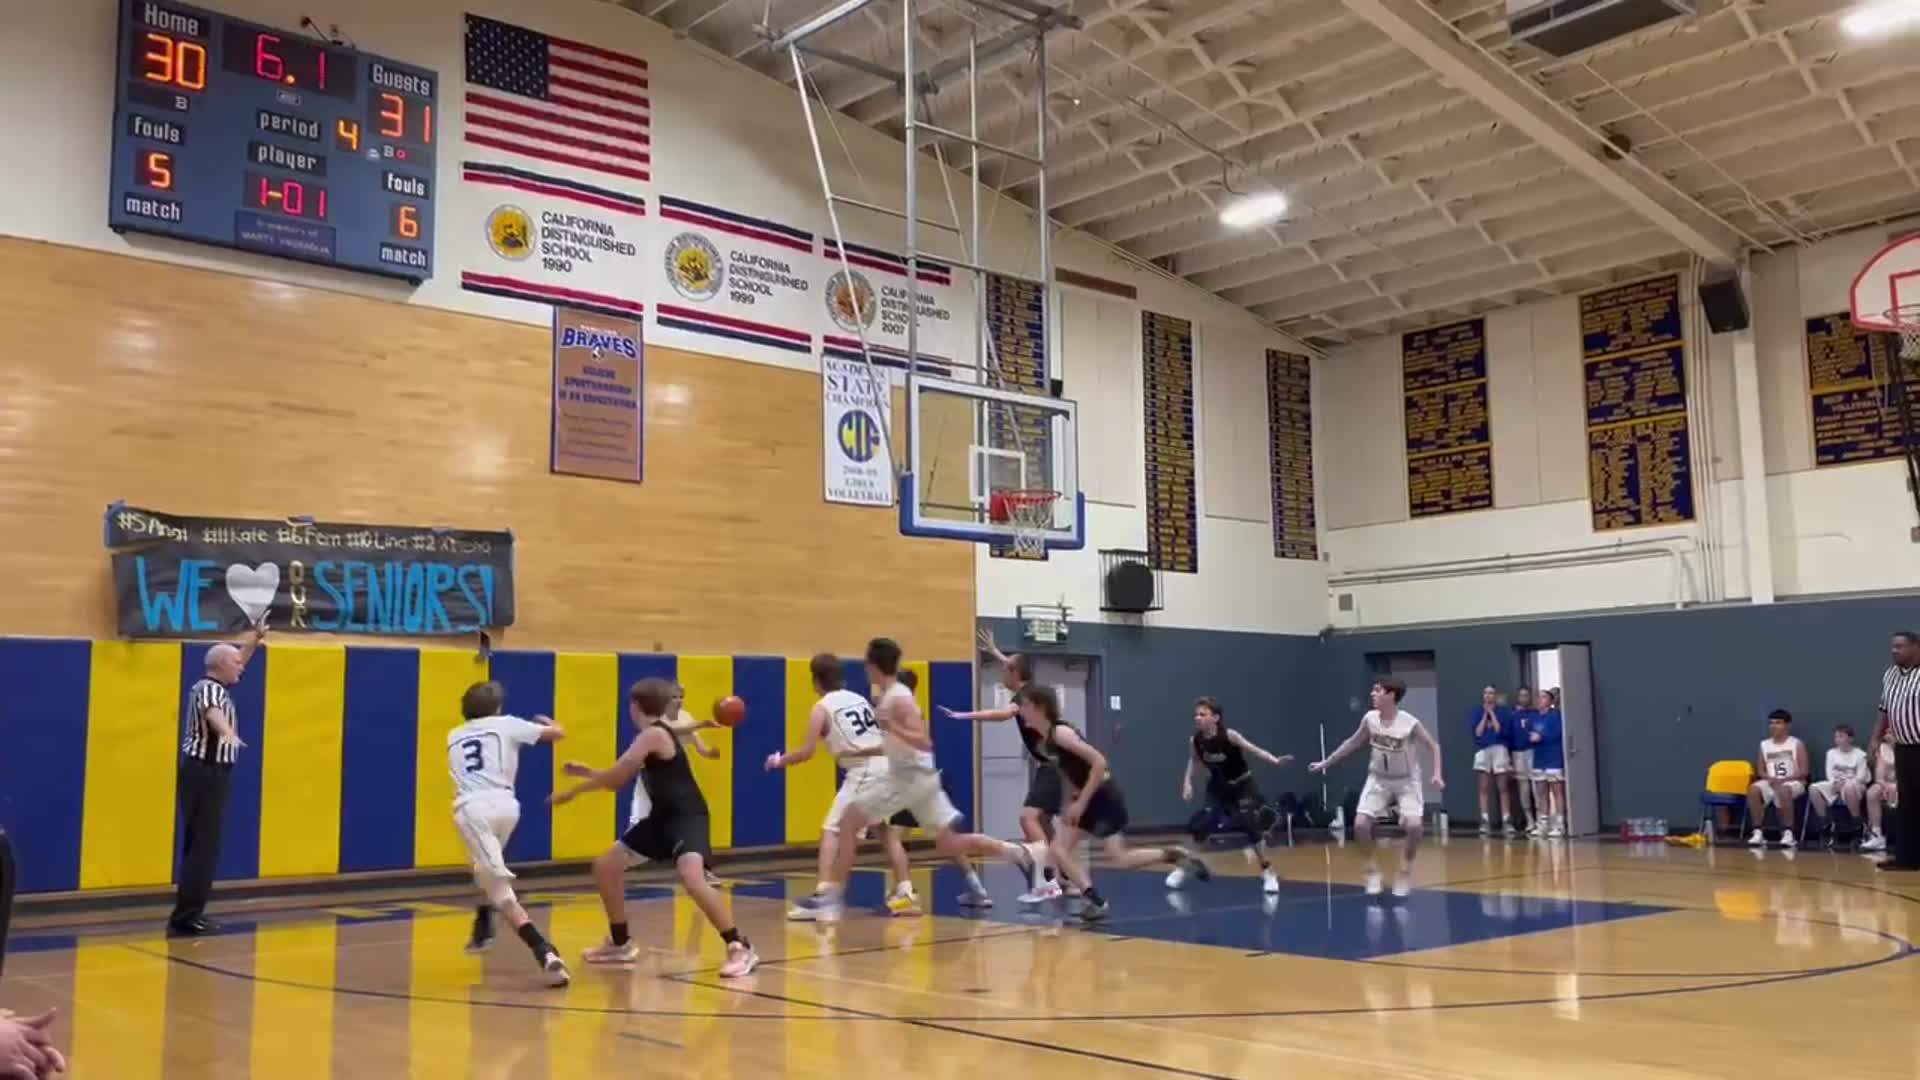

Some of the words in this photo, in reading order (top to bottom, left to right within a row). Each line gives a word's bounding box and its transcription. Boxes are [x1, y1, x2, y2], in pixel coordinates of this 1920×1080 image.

[144, 3, 200, 36] Home
[144, 33, 207, 90] 30
[255, 34, 326, 90] 6.1
[372, 63, 431, 96] Guests
[134, 116, 181, 143] fouls
[259, 109, 319, 139] period
[380, 93, 431, 144] 31
[338, 119, 359, 150] 4
[148, 153, 171, 189] 5
[257, 143, 317, 172] player
[387, 172, 425, 197] fouls
[125, 195, 182, 221] match
[399, 206, 418, 238] 6
[541, 211, 615, 237] CALIFORNIA
[541, 227, 636, 256] DISTINGUISHED
[541, 242, 593, 262] SCHOOL
[381, 246, 427, 268] match
[542, 258, 573, 273] 1990
[729, 250, 791, 274] CALIFORNIA
[728, 264, 809, 290] DISTINGUISHED
[728, 277, 773, 296] SCHOOL
[730, 291, 755, 305] 1999
[880, 286, 936, 306] CALIFRNIA
[880, 297, 951, 320] DISTINUISHED
[880, 310, 921, 327] SCHO
[561, 327, 638, 360] BRAVES
[136, 555, 220, 632] WE
[289, 560, 308, 628] OUR
[311, 560, 494, 633] SENIORS!
[845, 707, 880, 737] 34
[463, 739, 484, 773] 3
[1773, 762, 1788, 777] 15
